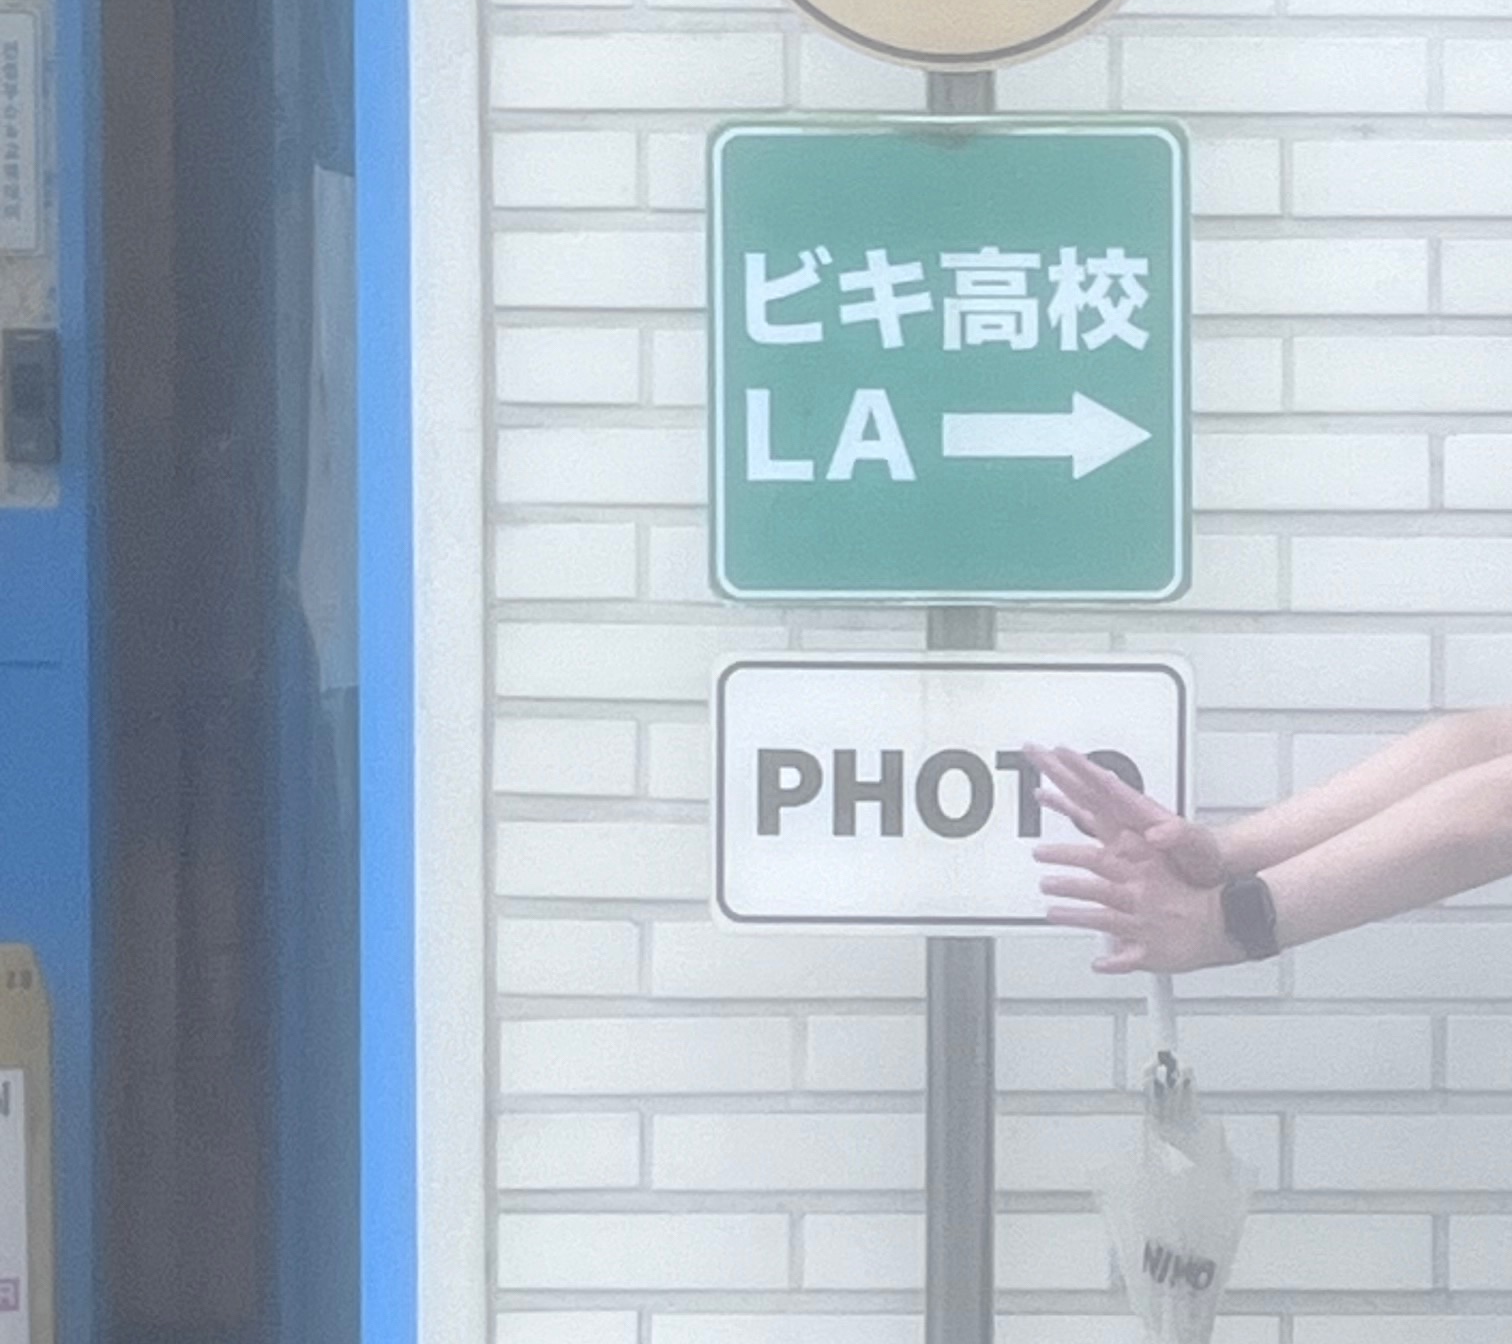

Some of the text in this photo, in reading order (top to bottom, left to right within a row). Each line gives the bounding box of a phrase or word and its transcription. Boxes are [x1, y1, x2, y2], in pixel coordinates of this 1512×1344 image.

[744, 244, 1152, 353] ビキ高校
[745, 387, 917, 482] LA
